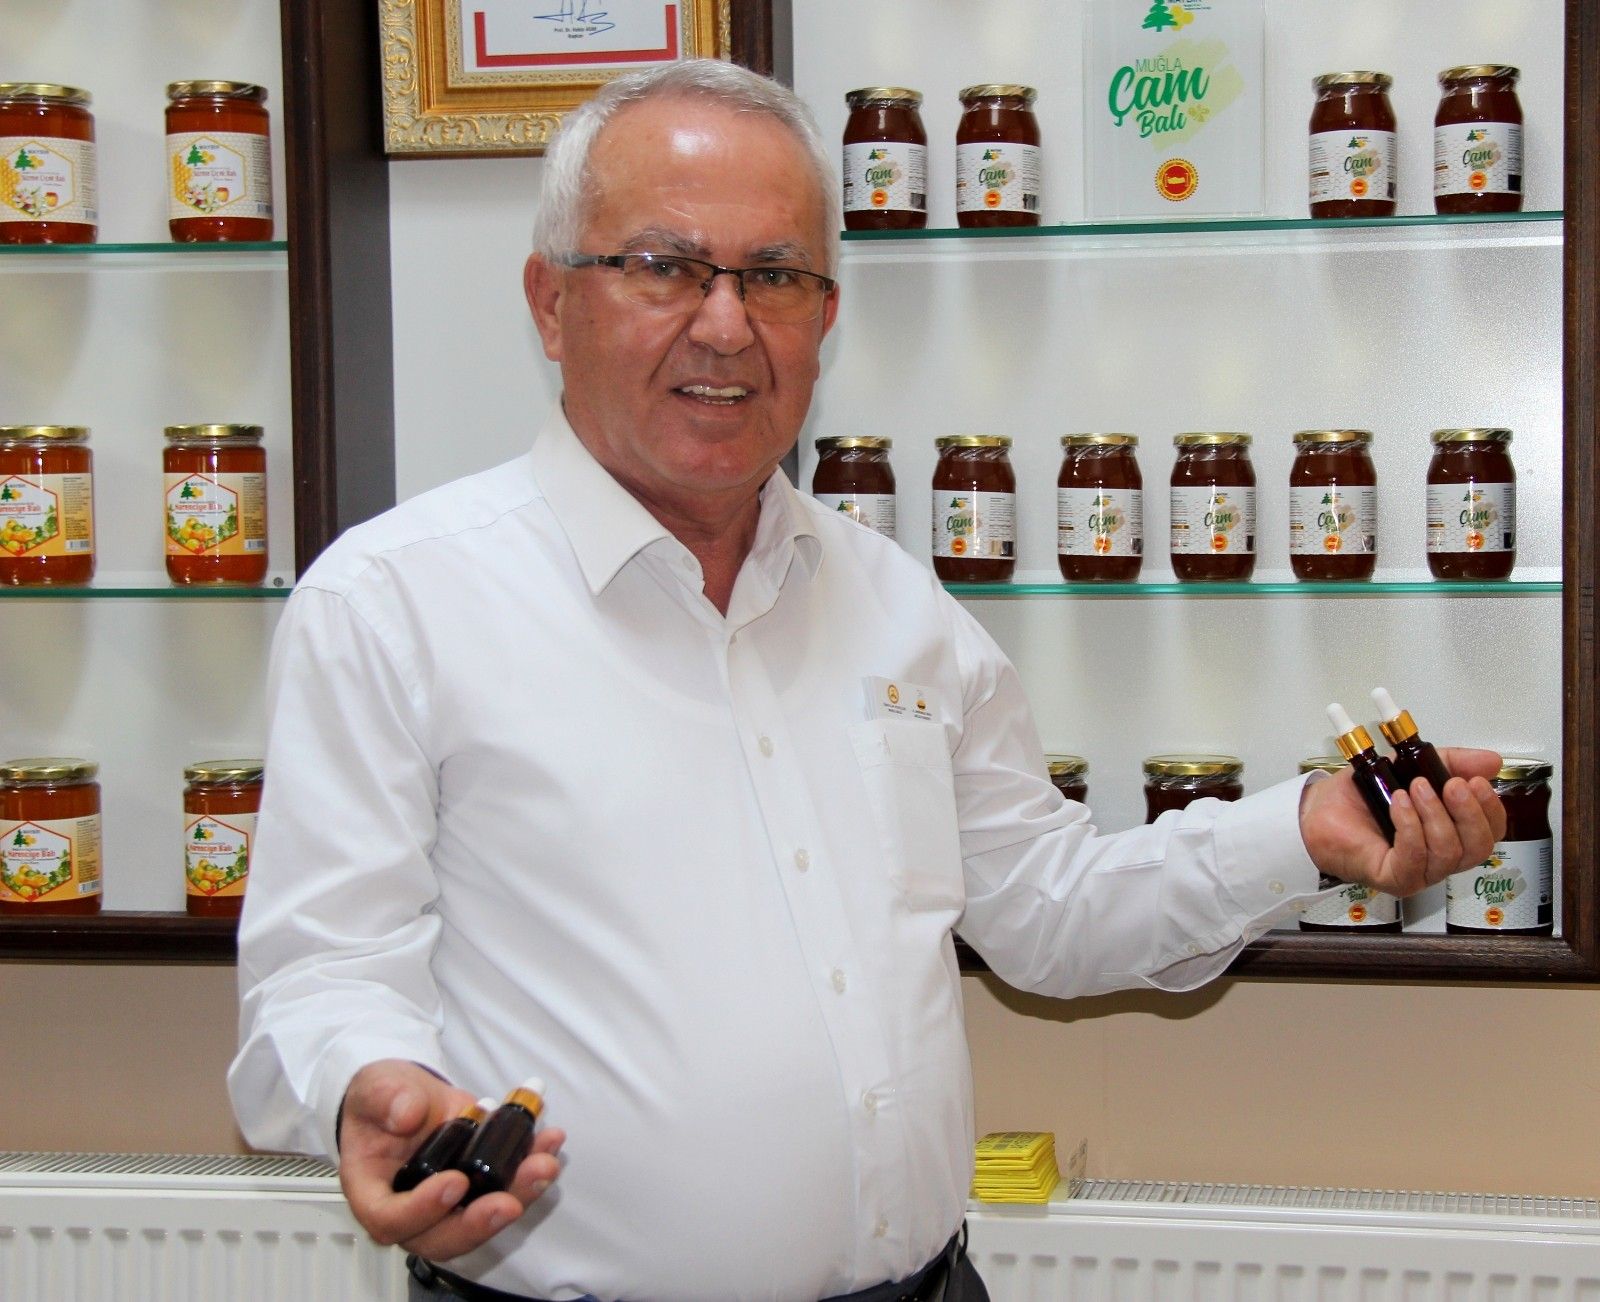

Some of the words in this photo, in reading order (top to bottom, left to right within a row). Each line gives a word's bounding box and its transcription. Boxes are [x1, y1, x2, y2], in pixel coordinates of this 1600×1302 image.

[1135, 55, 1183, 72] MUĞLA
[1108, 66, 1210, 127] Çam
[1135, 104, 1187, 138] Balı
[1474, 876, 1515, 900] Çam
[1485, 893, 1505, 905] Balı
